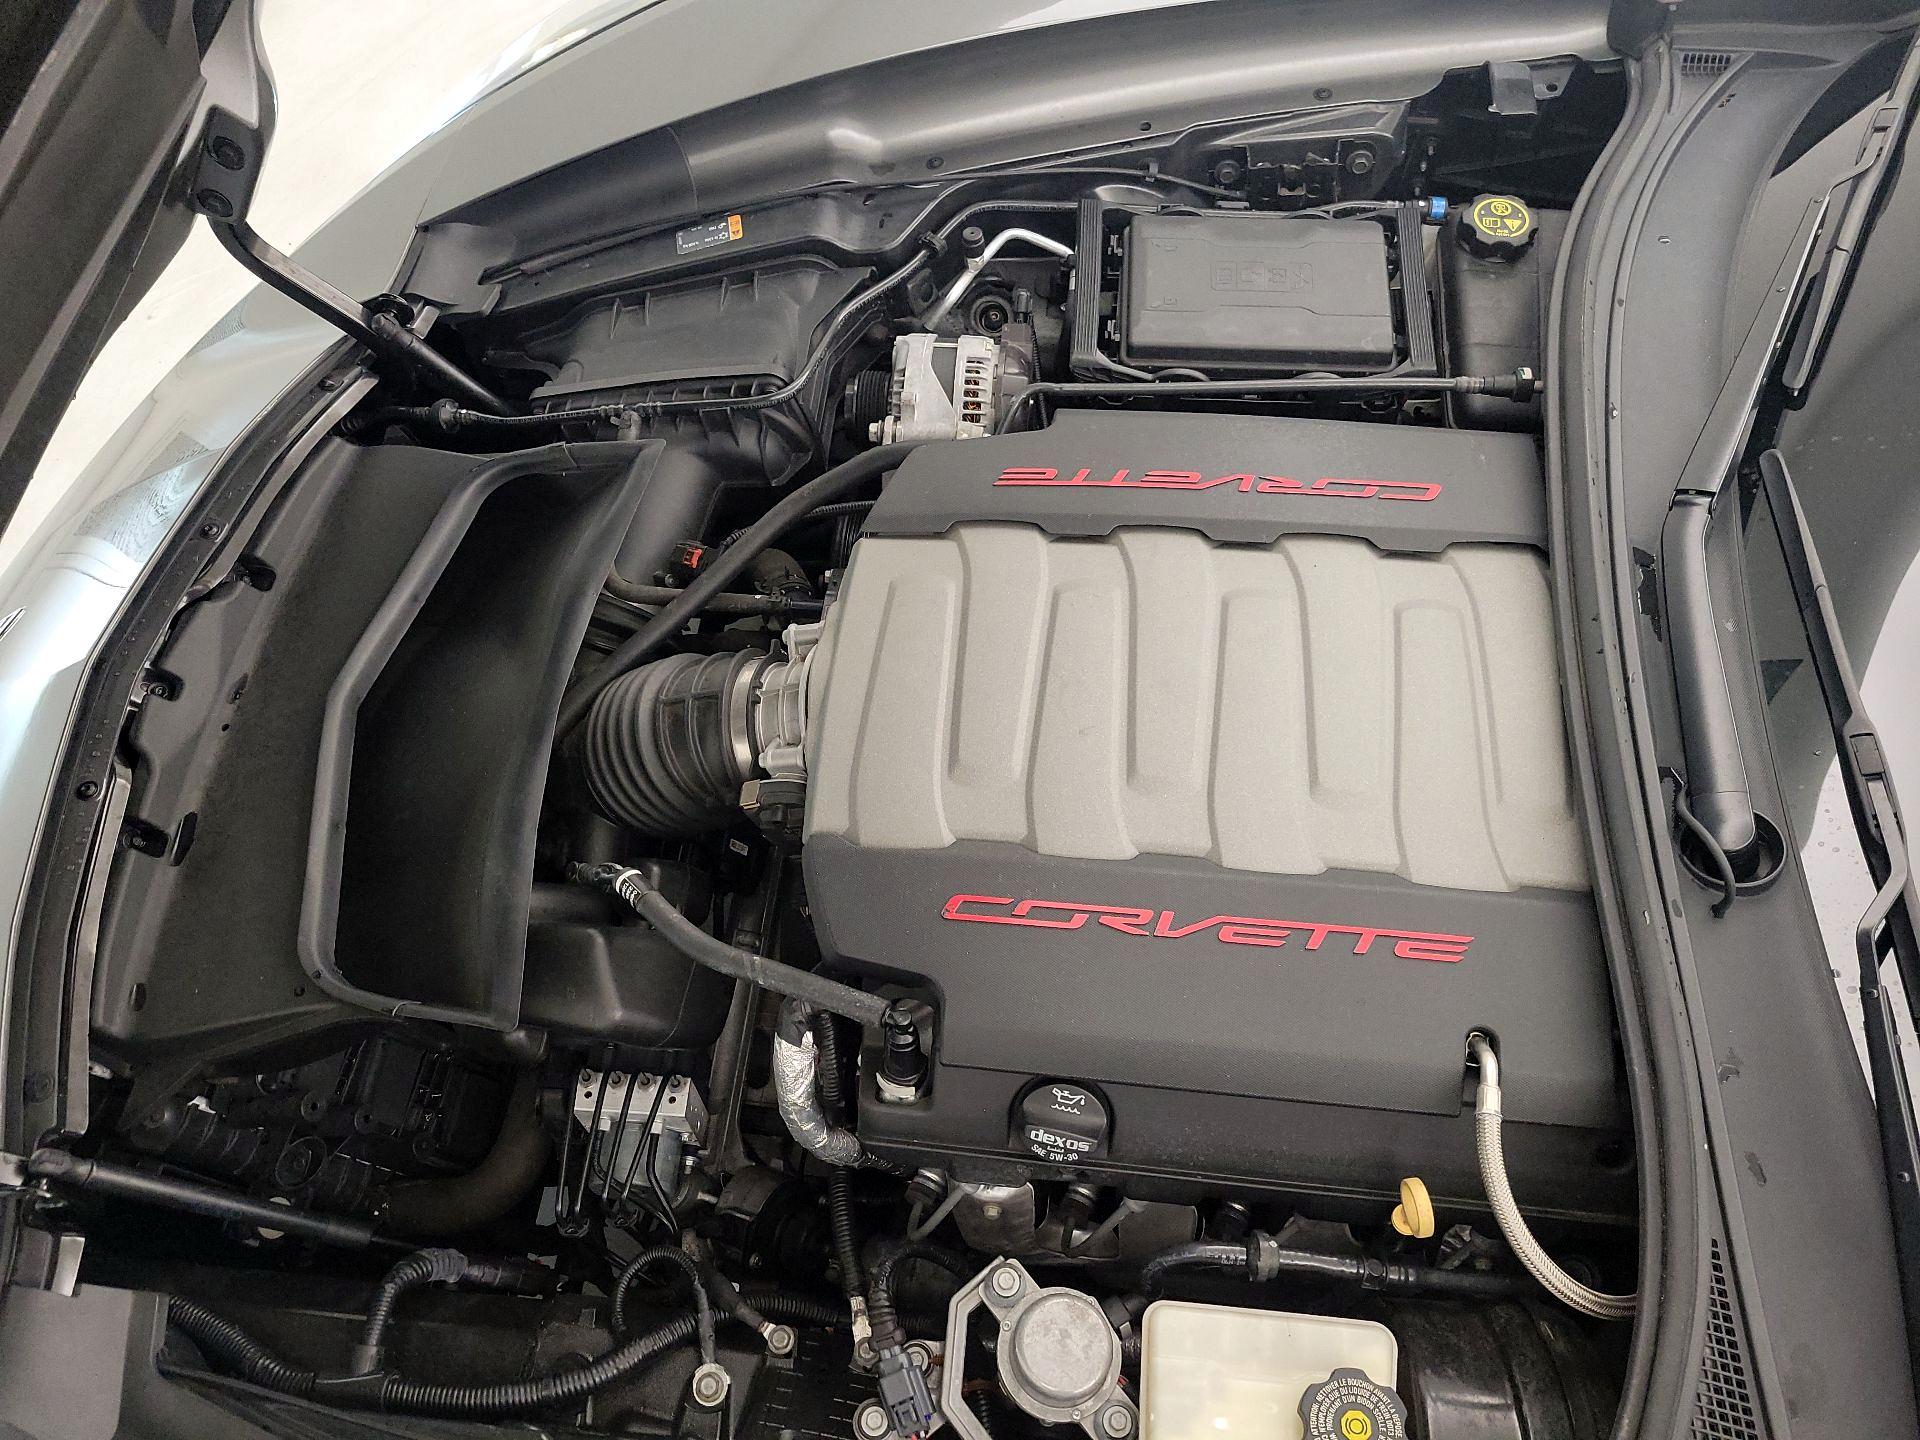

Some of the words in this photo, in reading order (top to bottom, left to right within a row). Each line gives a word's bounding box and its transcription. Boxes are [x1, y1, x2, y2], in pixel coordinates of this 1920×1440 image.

[992, 467, 1442, 501] CORVETTE
[940, 894, 1475, 963] CORVETTE
[1030, 1129, 1090, 1152] dexos
[1031, 1144, 1047, 1157] SAE
[1049, 1152, 1078, 1162] 5W-30
[1316, 1380, 1339, 1402] NETTOYER
[1339, 1378, 1347, 1387] LE
[1374, 1388, 1391, 1405] AVANT
[1388, 1404, 1396, 1414] LA
[1328, 1389, 1341, 1401] QUE
[1339, 1387, 1348, 1395] DU
[1370, 1394, 1379, 1404] DE
[1326, 1398, 1342, 1431] PROVENANT
[1356, 1395, 1375, 1410] BIDON
